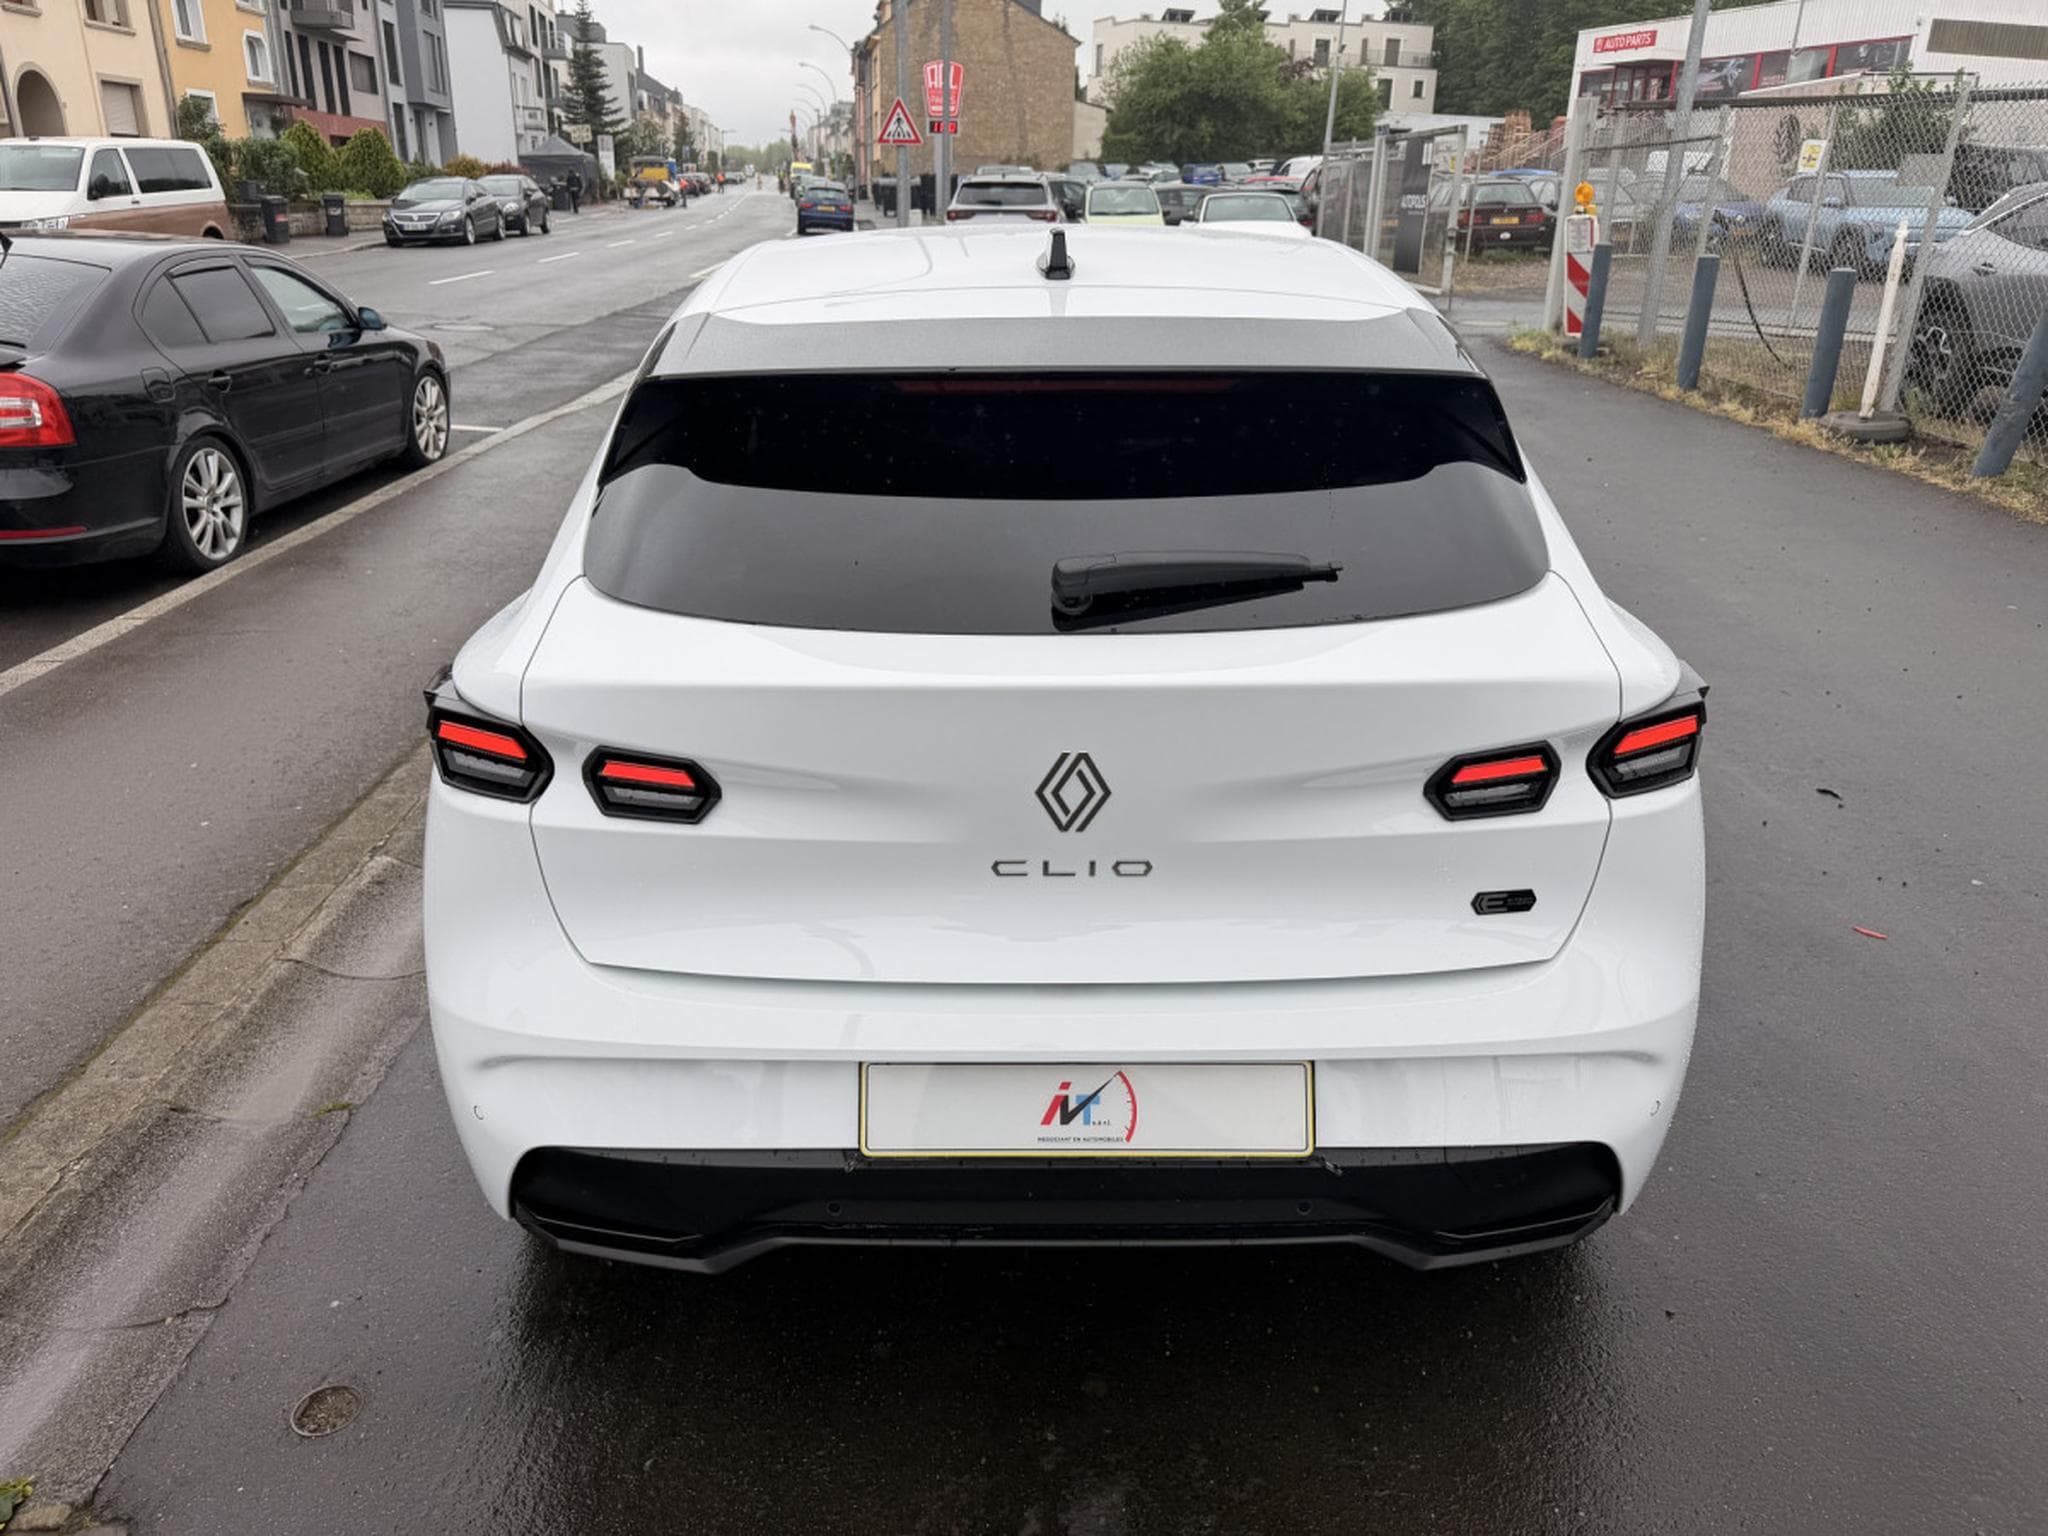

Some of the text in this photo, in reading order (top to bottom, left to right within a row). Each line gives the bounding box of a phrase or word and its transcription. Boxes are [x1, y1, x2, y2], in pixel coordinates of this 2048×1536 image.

[1603, 32, 1652, 50] AUTO PARTS
[991, 860, 1153, 877] CLIO
